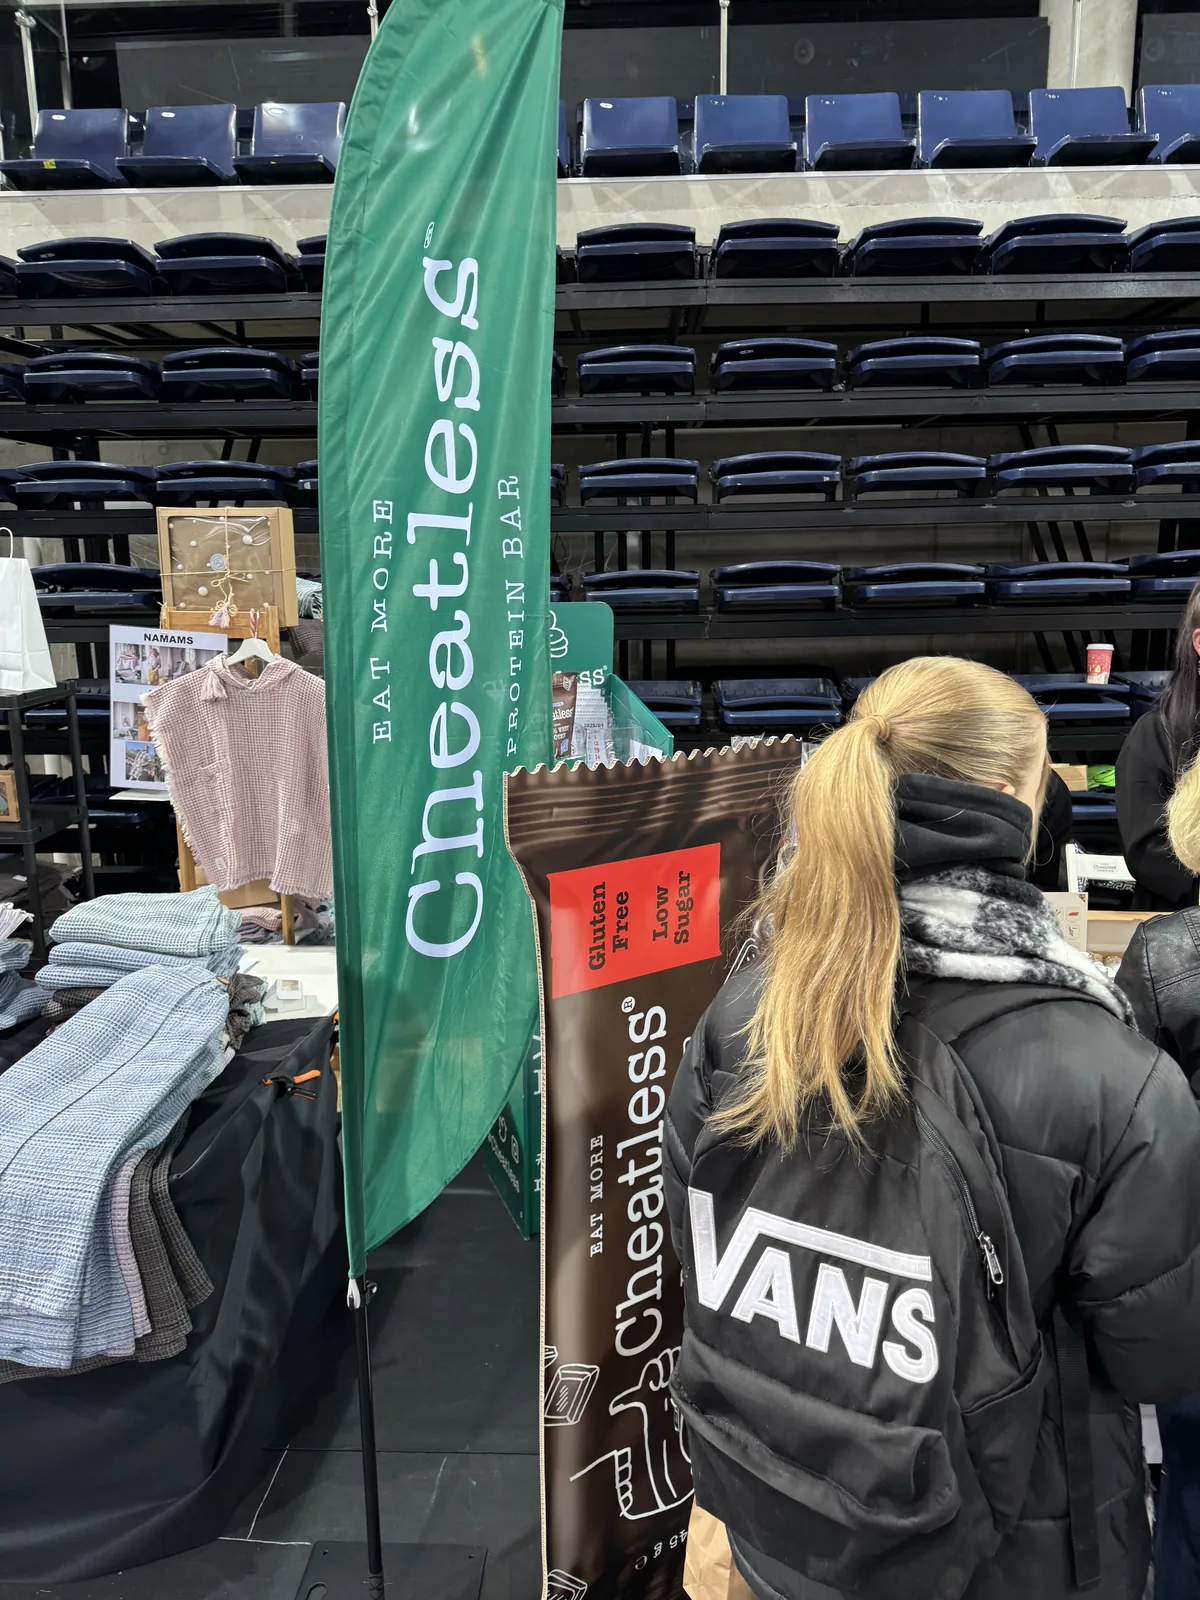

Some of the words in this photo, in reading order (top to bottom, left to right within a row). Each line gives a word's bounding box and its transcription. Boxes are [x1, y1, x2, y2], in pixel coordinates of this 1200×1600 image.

[498, 475, 524, 558] BAR
[370, 499, 394, 633] MORE
[143, 633, 194, 645] NAMAMS
[504, 579, 525, 757] PROTEIN
[370, 657, 392, 744] EAT
[588, 881, 606, 971] Gluten
[612, 890, 630, 953] Free
[652, 885, 669, 942] Low
[673, 871, 694, 945] Sugar
[590, 1134, 604, 1203] MORE
[590, 1214, 603, 1257] EAT
[687, 1186, 939, 1384] VANS
